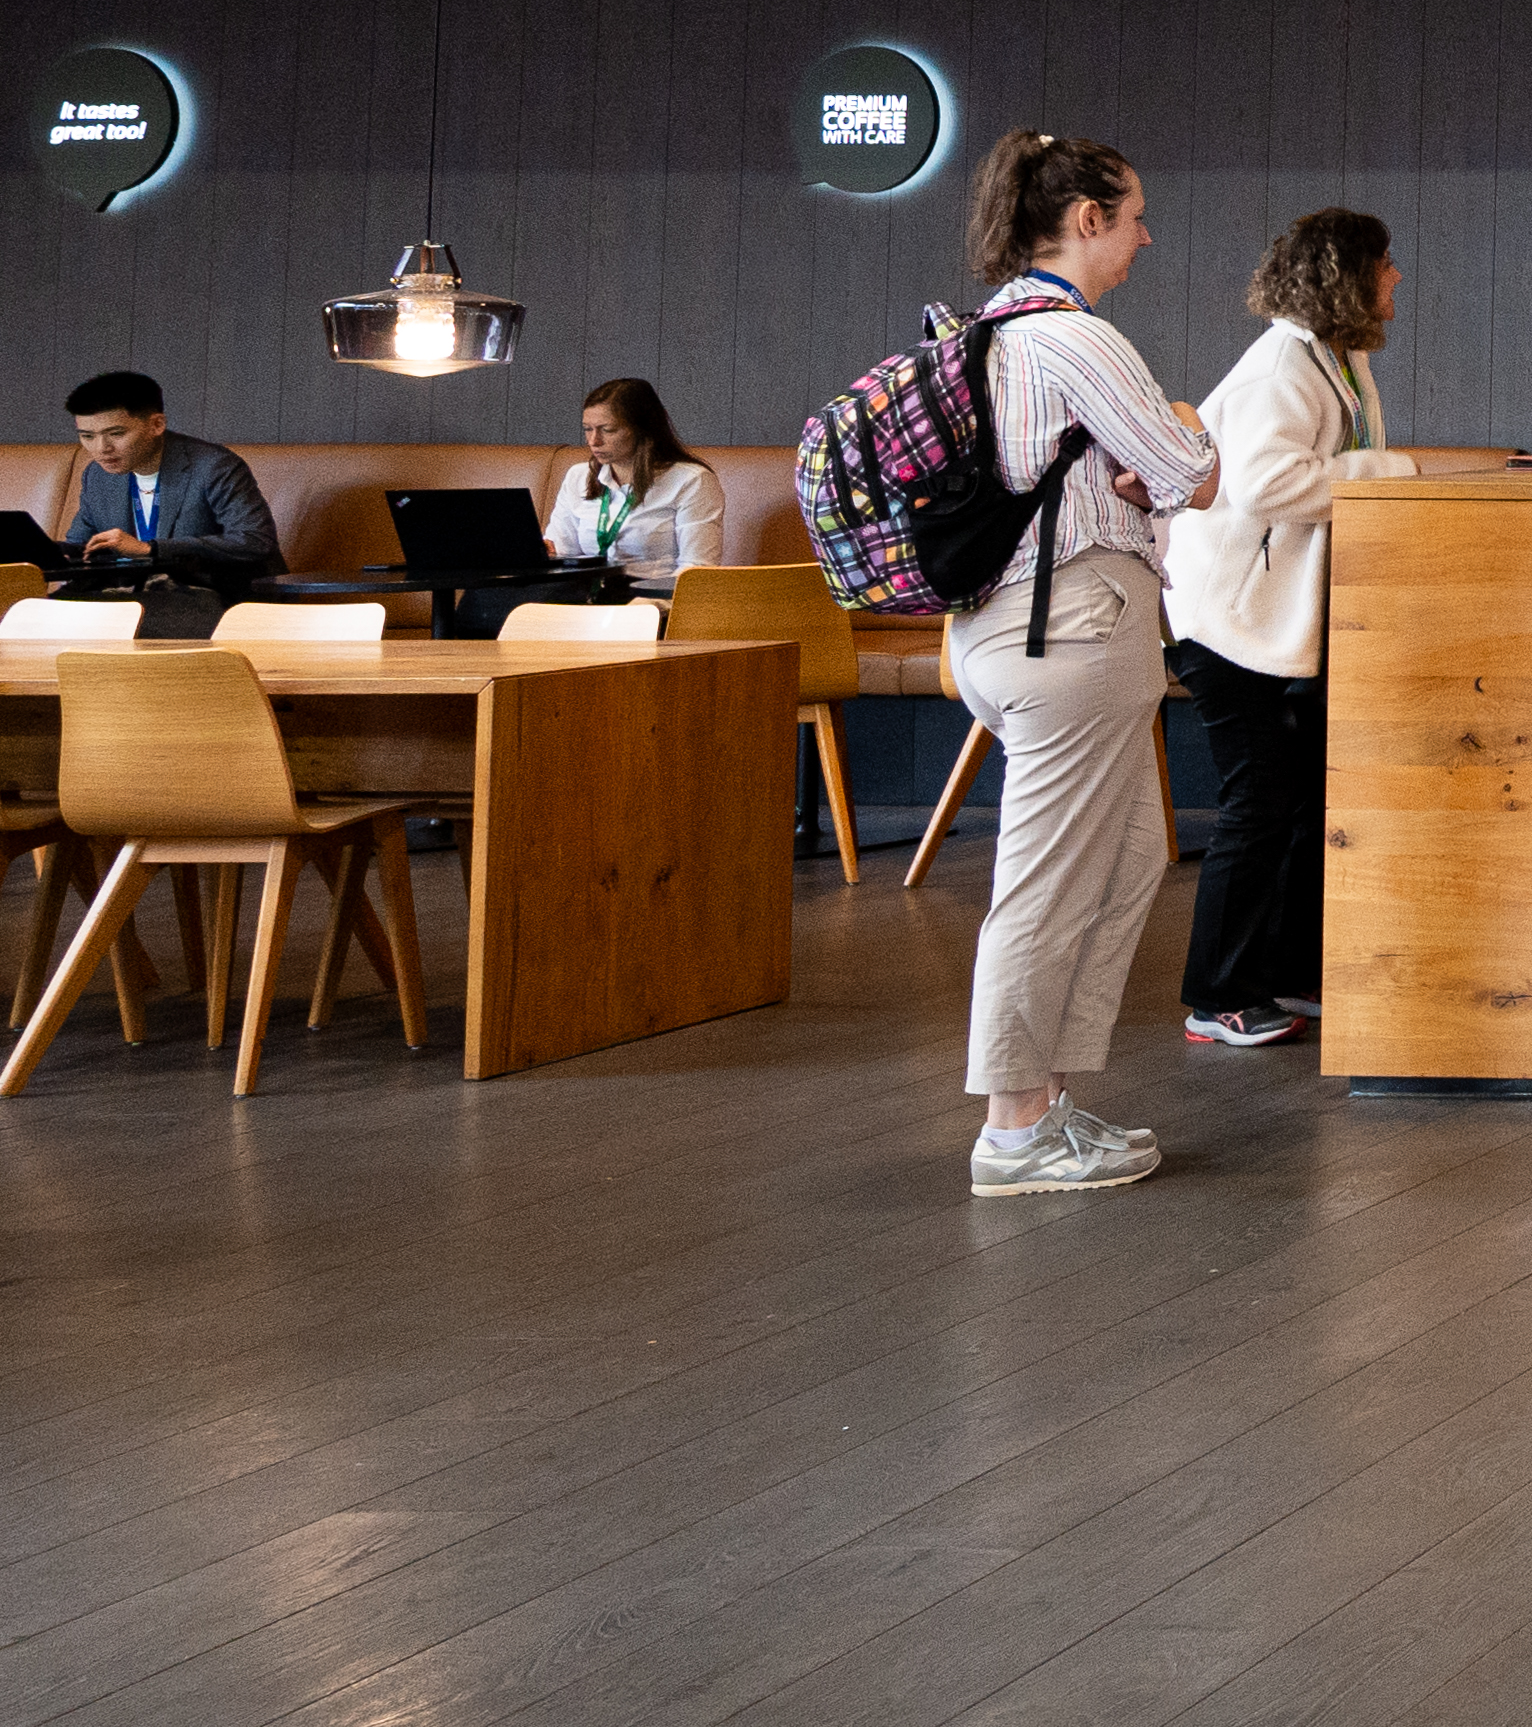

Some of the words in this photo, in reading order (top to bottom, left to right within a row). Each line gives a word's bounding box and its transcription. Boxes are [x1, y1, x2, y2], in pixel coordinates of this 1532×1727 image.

[60, 101, 76, 119] It
[77, 103, 140, 120] tastes
[823, 95, 908, 112] PREMIUM
[823, 111, 906, 130] COFFEE
[50, 124, 105, 144] great
[106, 121, 146, 139] too!
[822, 129, 863, 144] WITH
[864, 129, 906, 145] CARE
